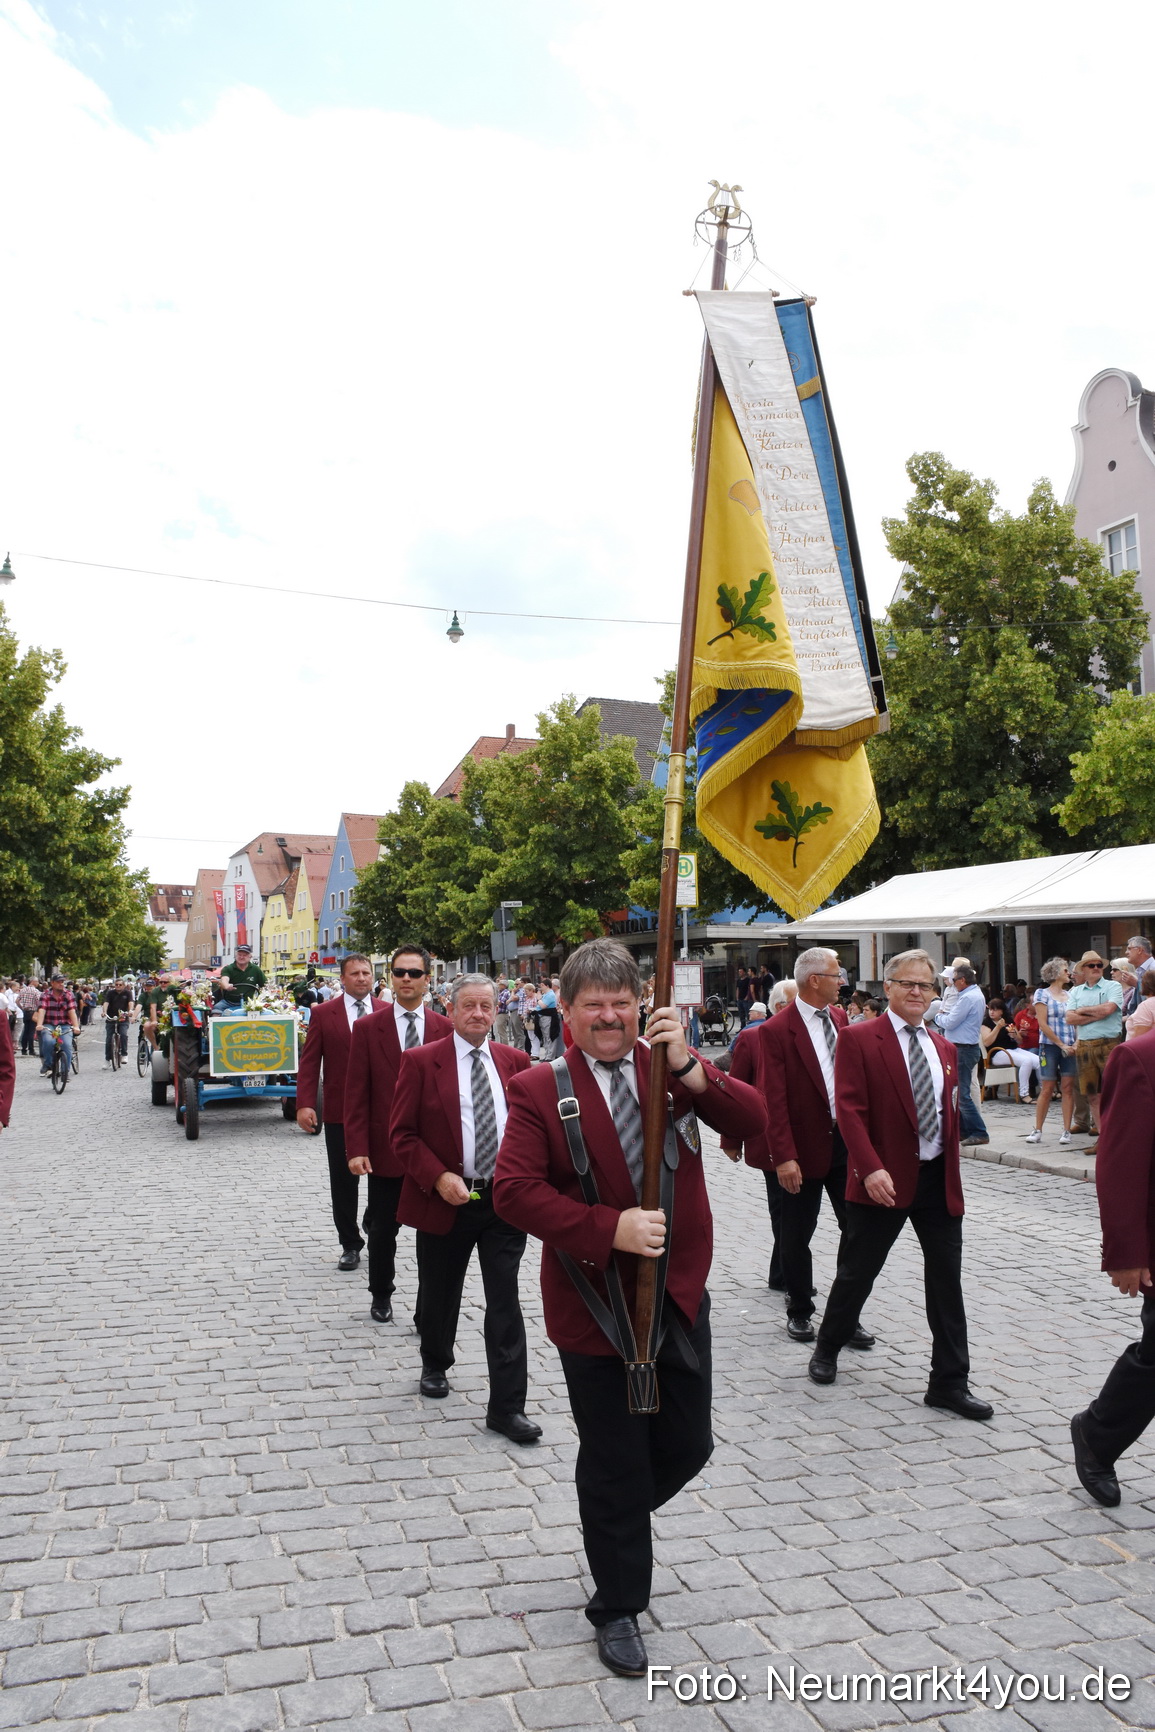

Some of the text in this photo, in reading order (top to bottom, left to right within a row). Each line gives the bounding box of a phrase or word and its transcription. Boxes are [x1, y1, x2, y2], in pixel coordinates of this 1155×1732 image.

[756, 438, 803, 453] Kratzer
[778, 532, 826, 548] Hafner
[779, 585, 820, 595] lisabeth
[804, 595, 843, 608] Adler
[799, 627, 848, 642] Englisch
[793, 648, 840, 659] nnemarie
